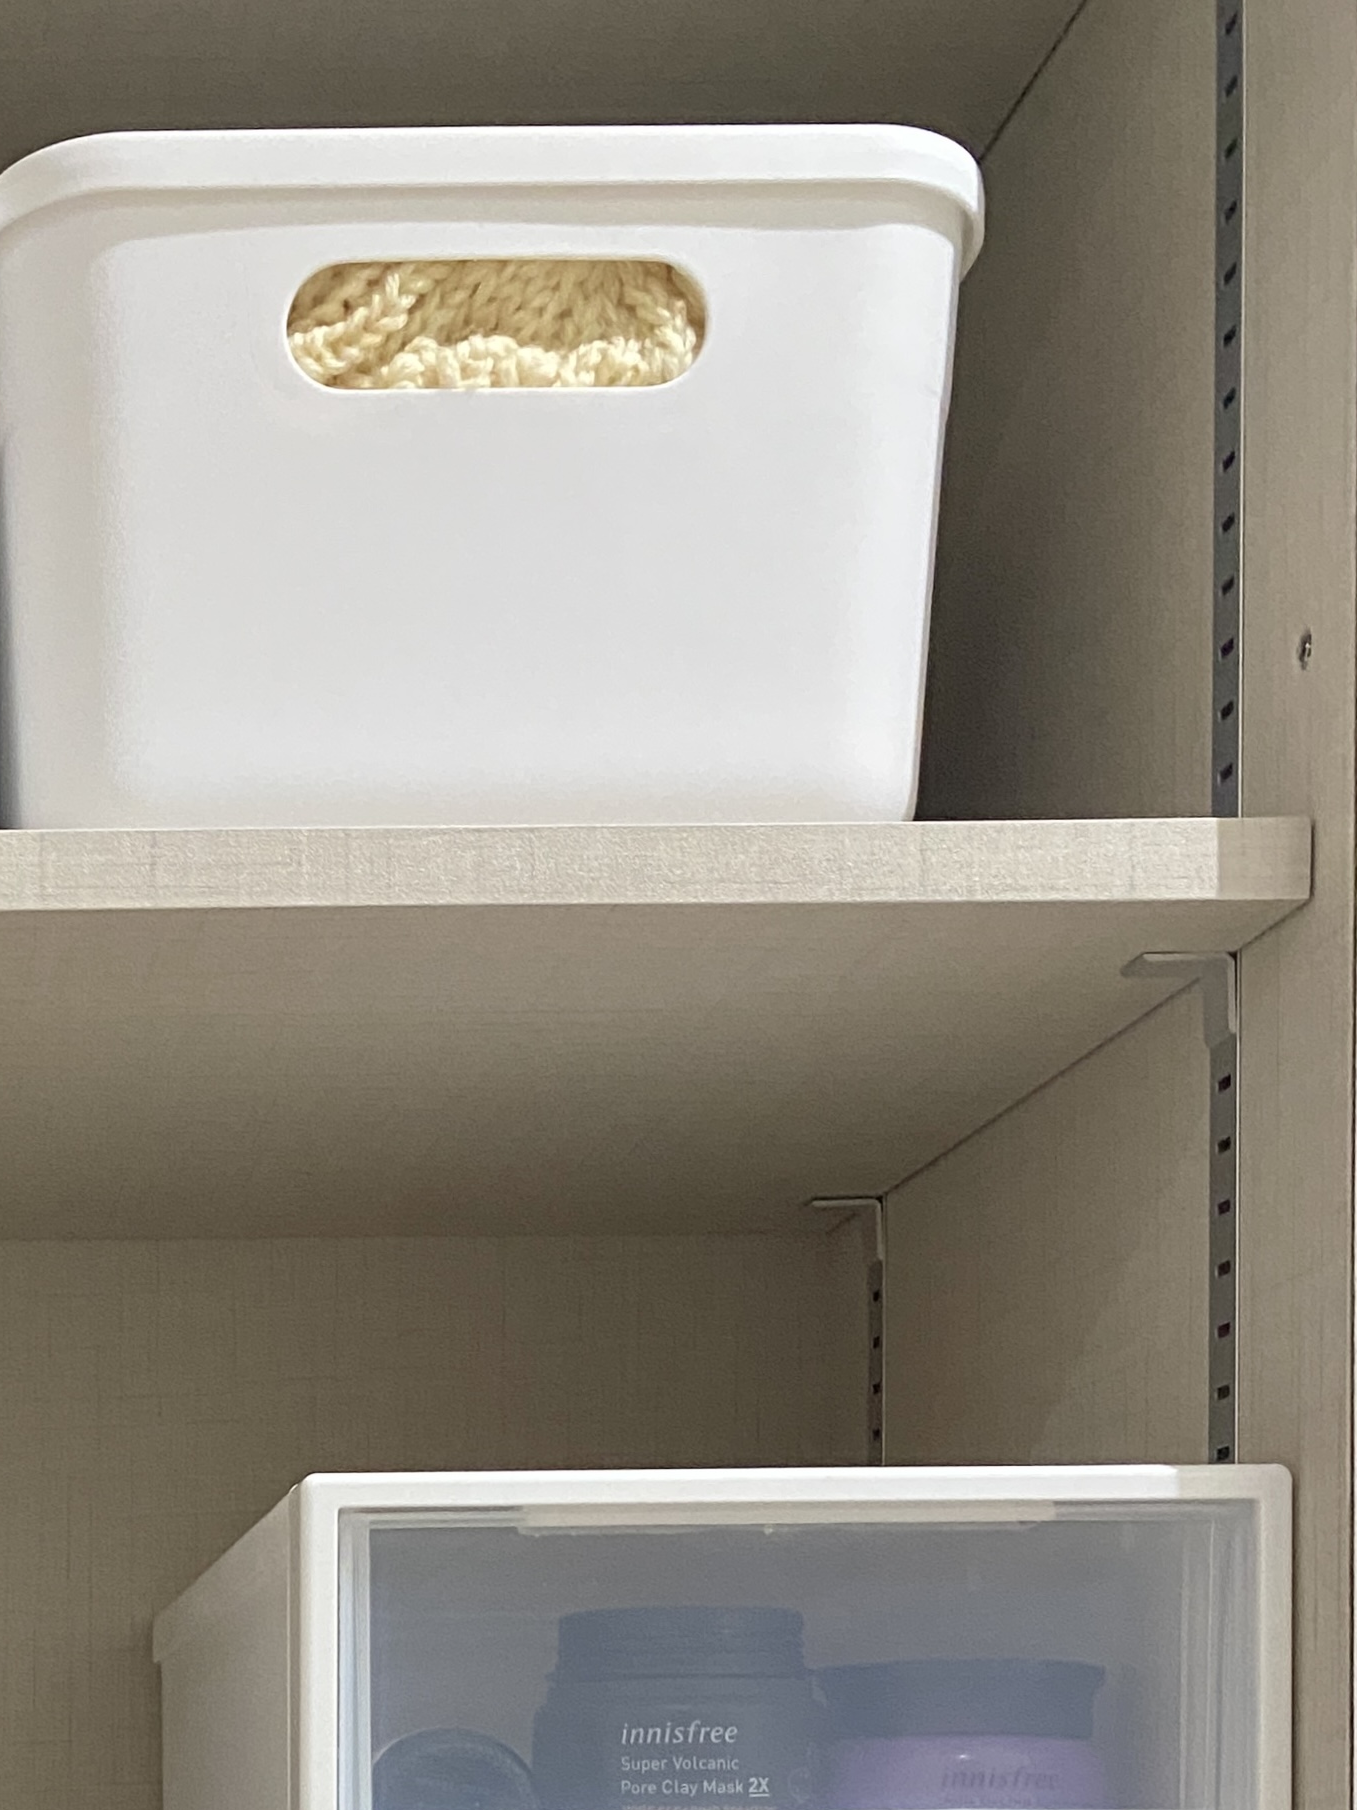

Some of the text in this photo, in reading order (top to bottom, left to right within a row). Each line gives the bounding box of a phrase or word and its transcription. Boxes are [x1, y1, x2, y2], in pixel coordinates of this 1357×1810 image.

[621, 1720, 738, 1744] innisfree
[621, 1756, 739, 1774] Super Volcanic
[621, 1777, 770, 1797] Pore Clay Mask 2X
